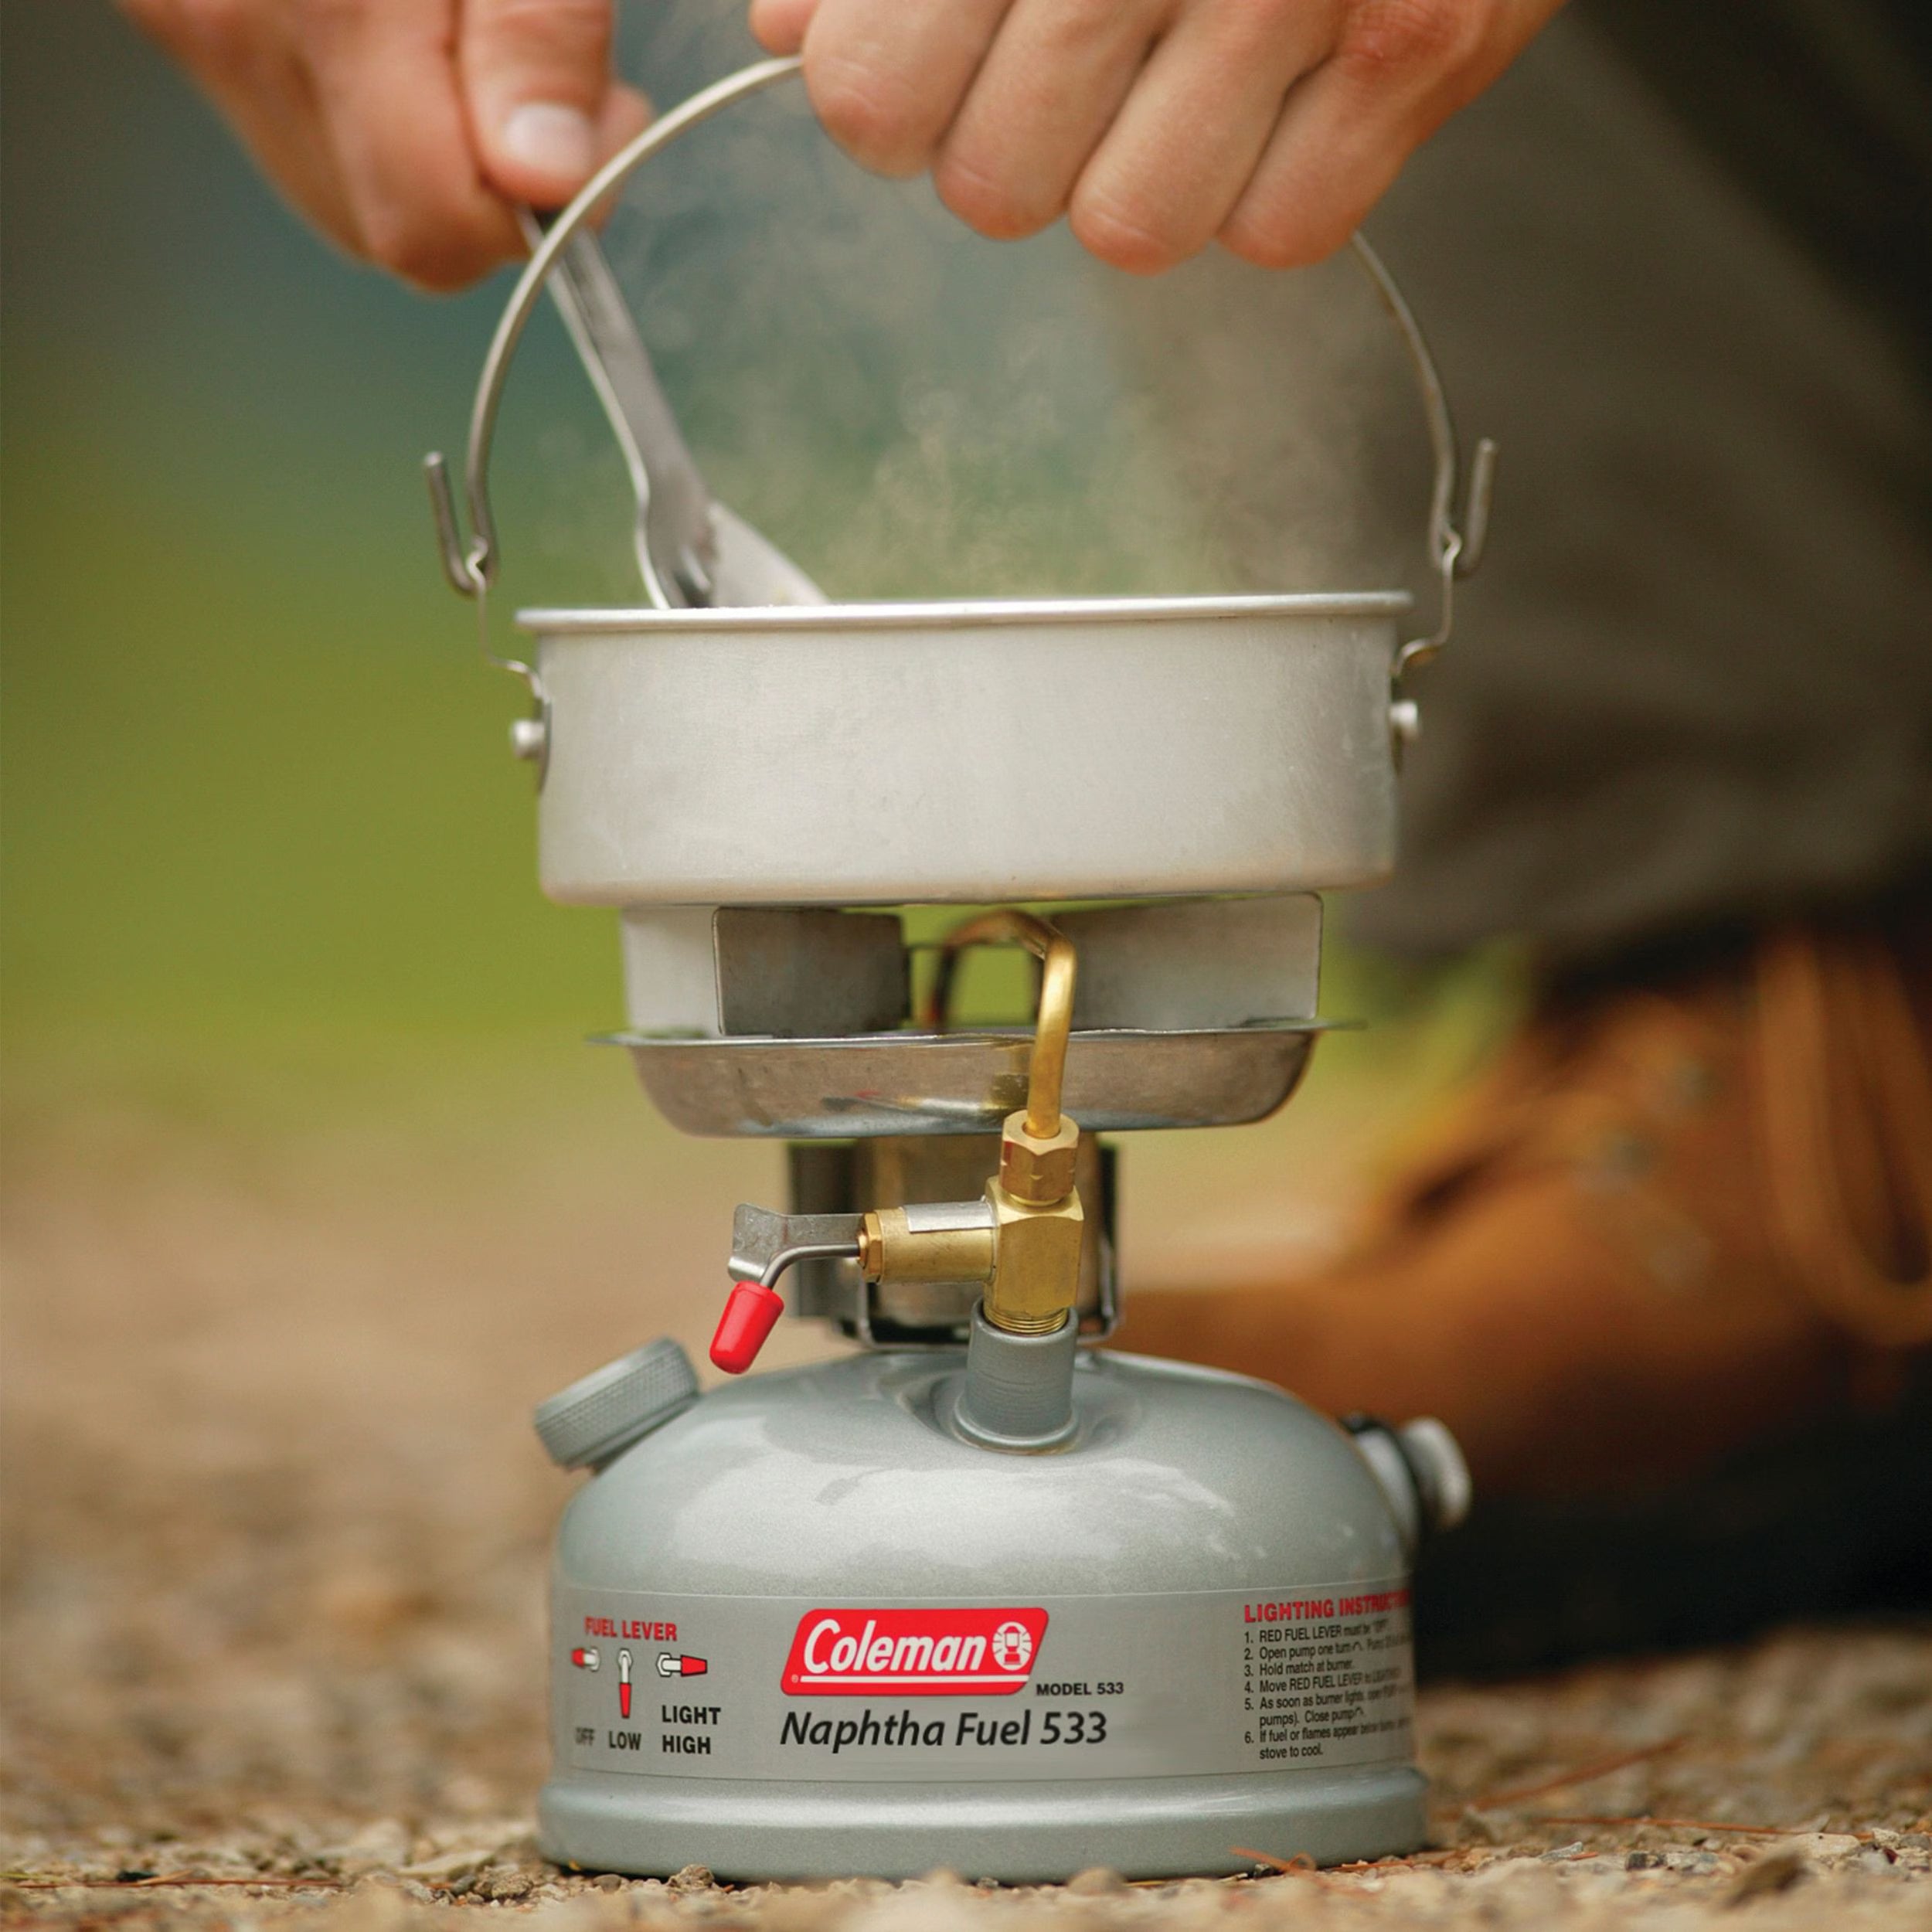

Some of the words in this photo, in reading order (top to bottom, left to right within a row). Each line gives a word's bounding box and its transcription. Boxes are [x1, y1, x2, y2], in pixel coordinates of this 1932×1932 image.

[1244, 1599, 1334, 1623] LIGHTING
[585, 1616, 617, 1638] FUEL
[622, 1620, 678, 1641] LEVER
[1260, 1629, 1282, 1643] RED
[1284, 1628, 1310, 1641] FUEL
[1313, 1625, 1342, 1639] LEVER
[804, 1618, 987, 1674] Coleman
[1260, 1647, 1287, 1662] Open
[1289, 1646, 1315, 1662] pump
[1318, 1645, 1334, 1655] one
[1260, 1663, 1283, 1676] Hold
[1286, 1661, 1314, 1675] match
[1316, 1661, 1325, 1673] at
[1036, 1683, 1092, 1696] MODEL
[1097, 1682, 1124, 1695] 533
[1260, 1680, 1287, 1692] Move
[1289, 1678, 1311, 1692] RED
[1313, 1675, 1335, 1689] FUEL
[1338, 1673, 1362, 1688] LEVER
[1260, 1698, 1274, 1709] As
[1276, 1698, 1301, 1709] soon
[1303, 1696, 1314, 1706] as
[1316, 1692, 1343, 1706] burner
[662, 1705, 721, 1725] LIGHT
[1304, 1709, 1329, 1723] Close
[609, 1730, 641, 1750] LOW
[780, 1709, 945, 1753] Naphtha
[955, 1709, 1031, 1746] Fuel
[1040, 1711, 1107, 1744] 533
[1260, 1730, 1266, 1743] If
[1269, 1729, 1287, 1743] fuel
[1290, 1730, 1300, 1740] or
[1302, 1726, 1331, 1740] flames
[662, 1735, 711, 1754] HIGH
[1260, 1746, 1287, 1760] stove
[1289, 1745, 1300, 1757] to
